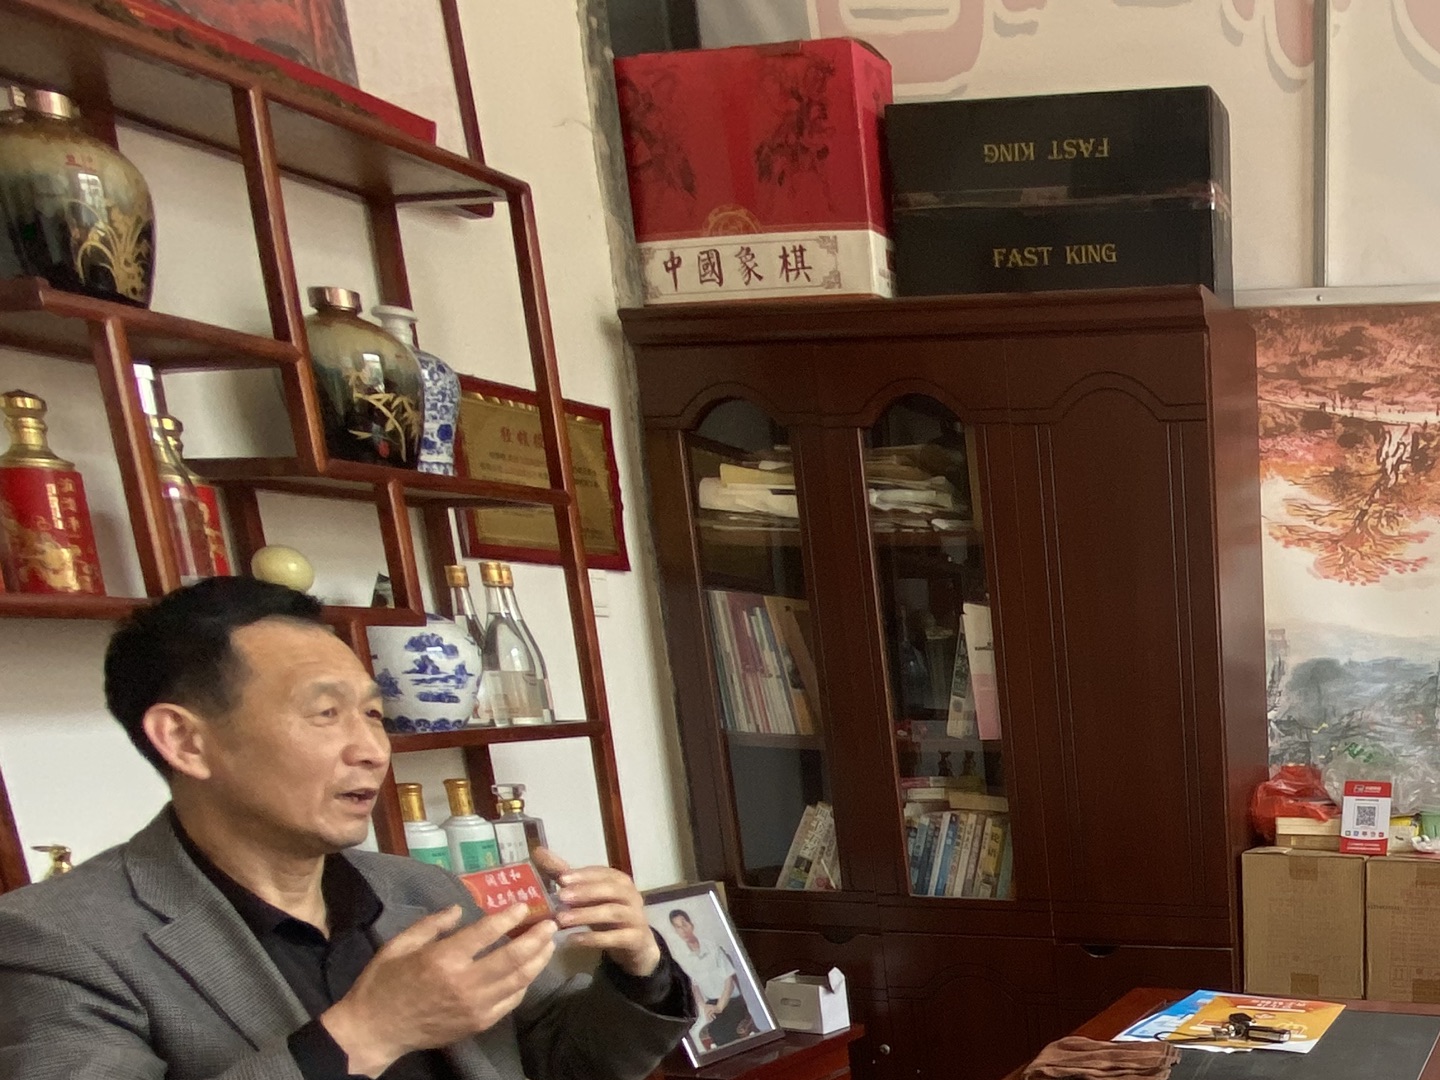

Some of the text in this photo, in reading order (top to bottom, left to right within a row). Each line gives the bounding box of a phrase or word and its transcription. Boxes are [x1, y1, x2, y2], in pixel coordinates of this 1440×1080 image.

[983, 137, 1109, 164] FAST KING
[663, 245, 813, 290] 中國象棋
[994, 243, 1117, 267] FAST KING
